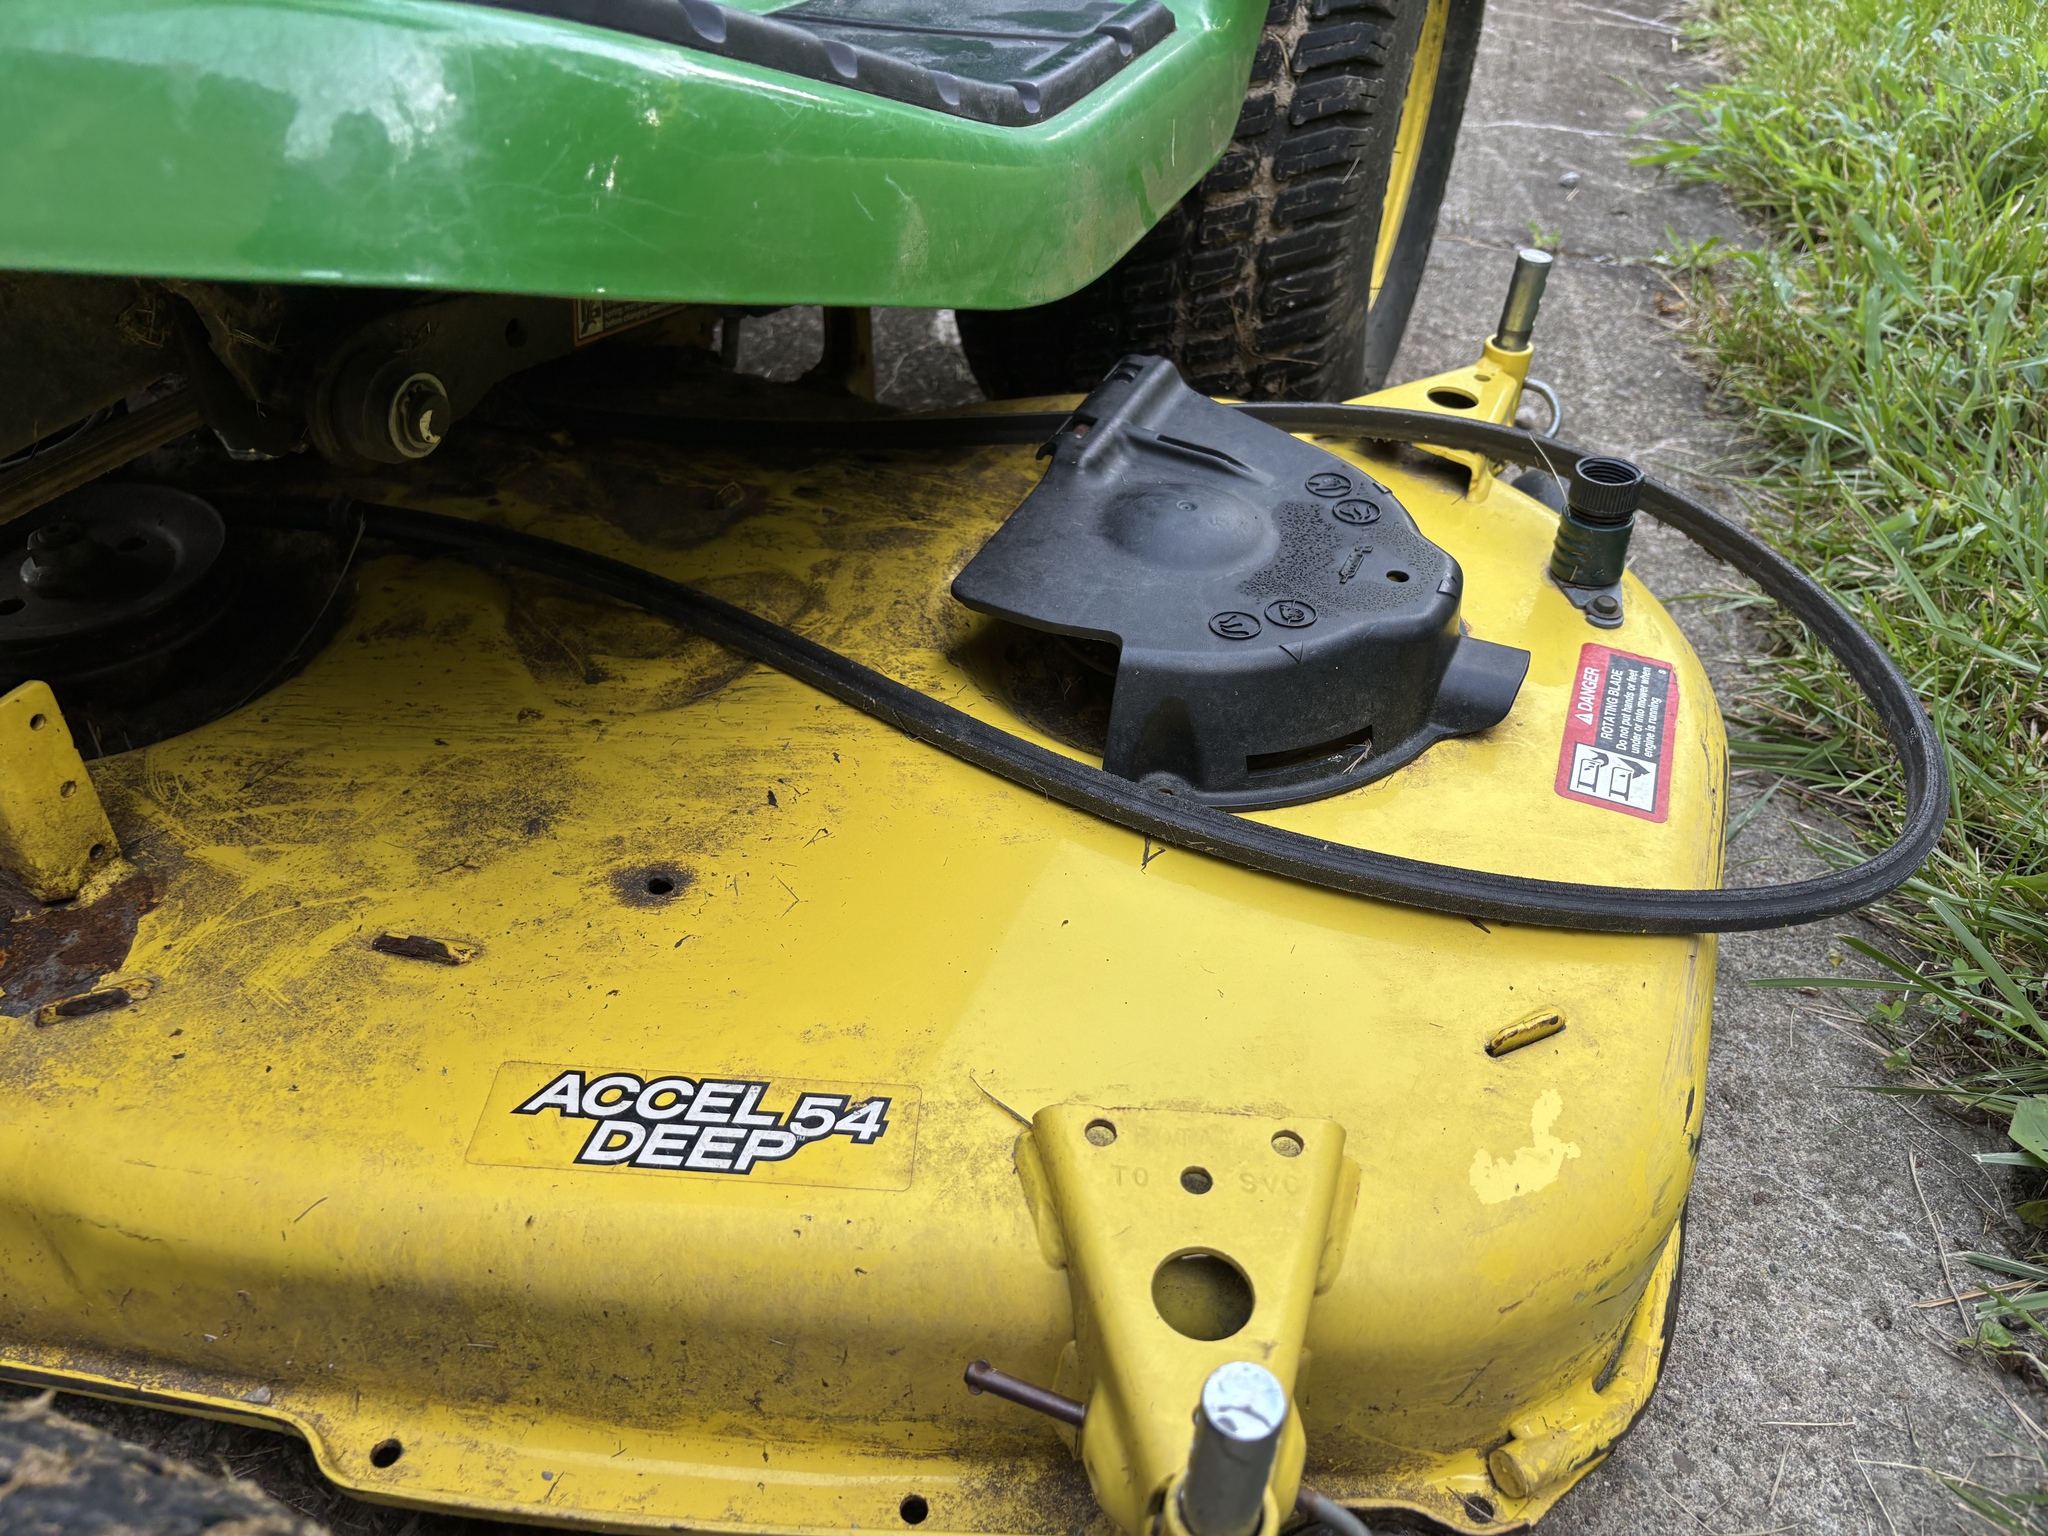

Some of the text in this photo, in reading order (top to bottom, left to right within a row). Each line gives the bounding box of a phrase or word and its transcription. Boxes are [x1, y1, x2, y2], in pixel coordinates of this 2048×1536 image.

[1577, 666, 1600, 712] DANGER
[1600, 668, 1623, 740] ROTATING BLADE
[1616, 668, 1639, 751] Do not put hands or feet
[1631, 666, 1652, 754] under or into mower when
[1644, 697, 1662, 758] engine is running
[518, 1072, 886, 1141] ACCEL 54
[579, 1119, 798, 1171] DEEP
[1110, 1163, 1149, 1188] TO
